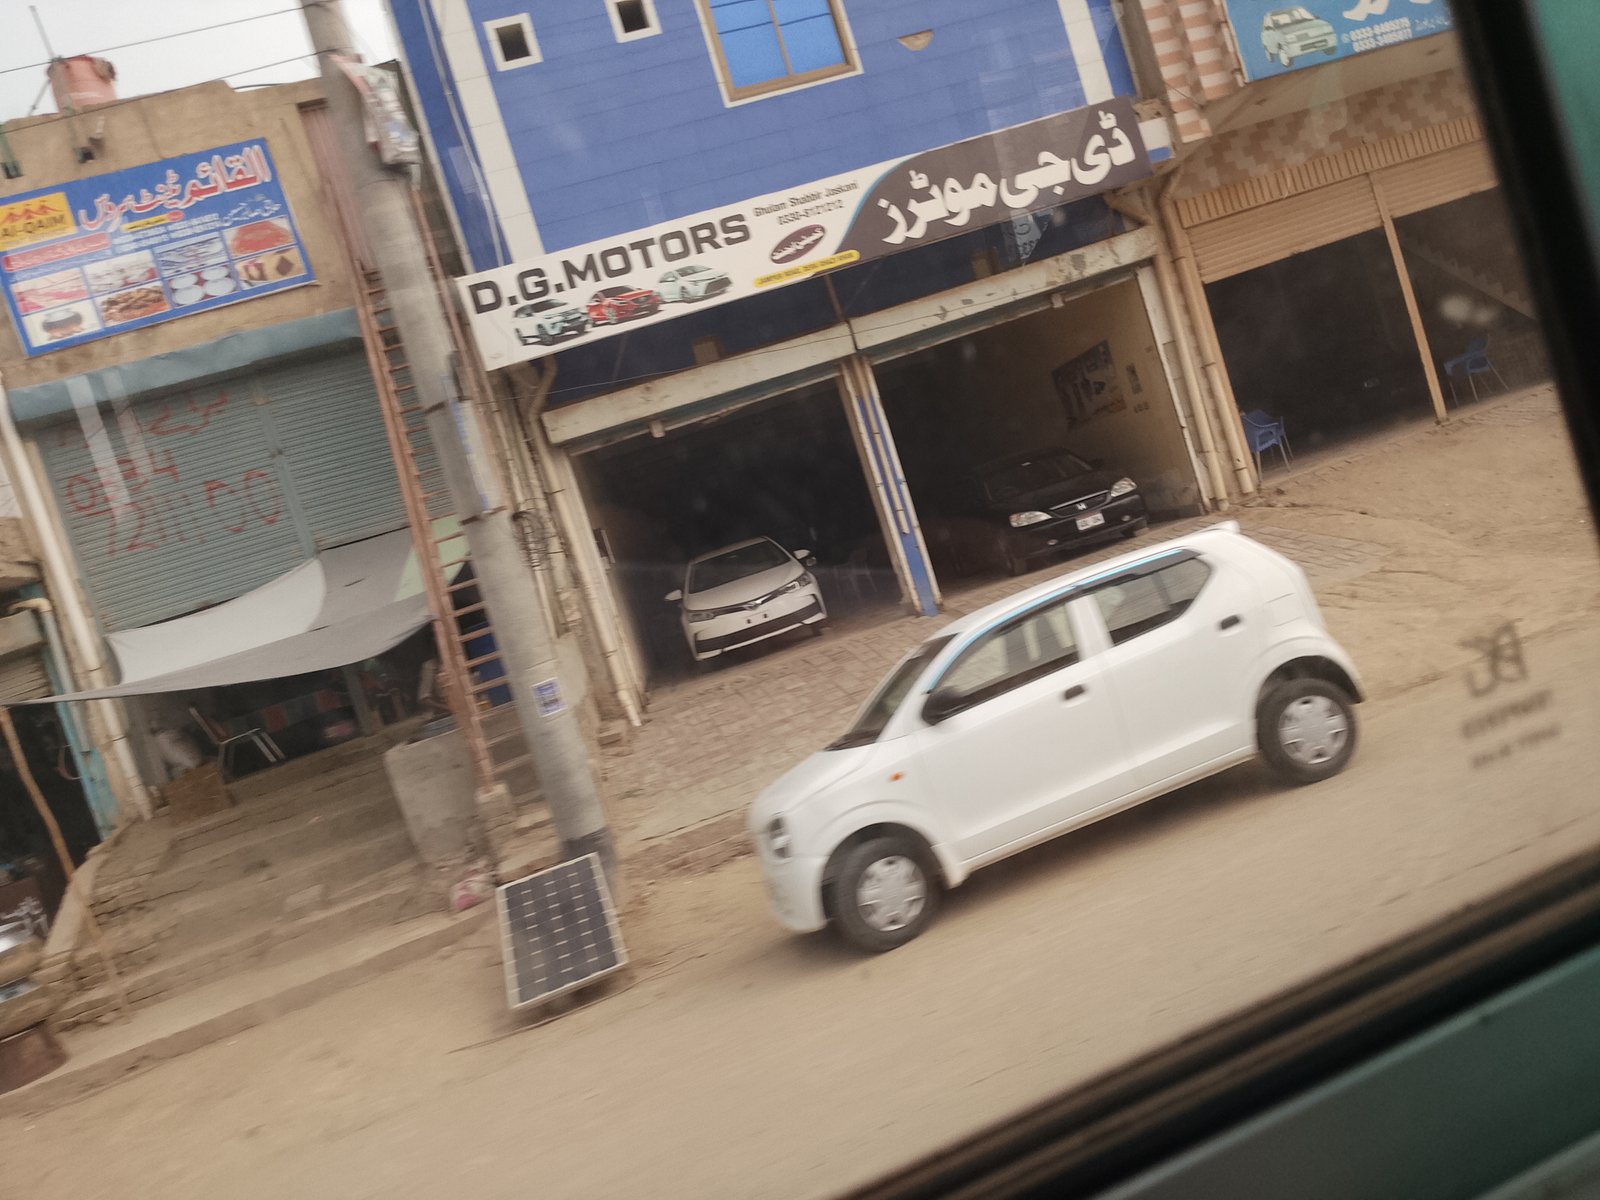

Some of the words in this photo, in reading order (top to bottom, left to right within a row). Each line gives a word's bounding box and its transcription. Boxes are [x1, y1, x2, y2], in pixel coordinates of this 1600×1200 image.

[999, 150, 1072, 209] جی
[1070, 110, 1136, 185] ڈی
[877, 168, 998, 245] موٹرز
[468, 213, 751, 314] D.G.MOTORS
